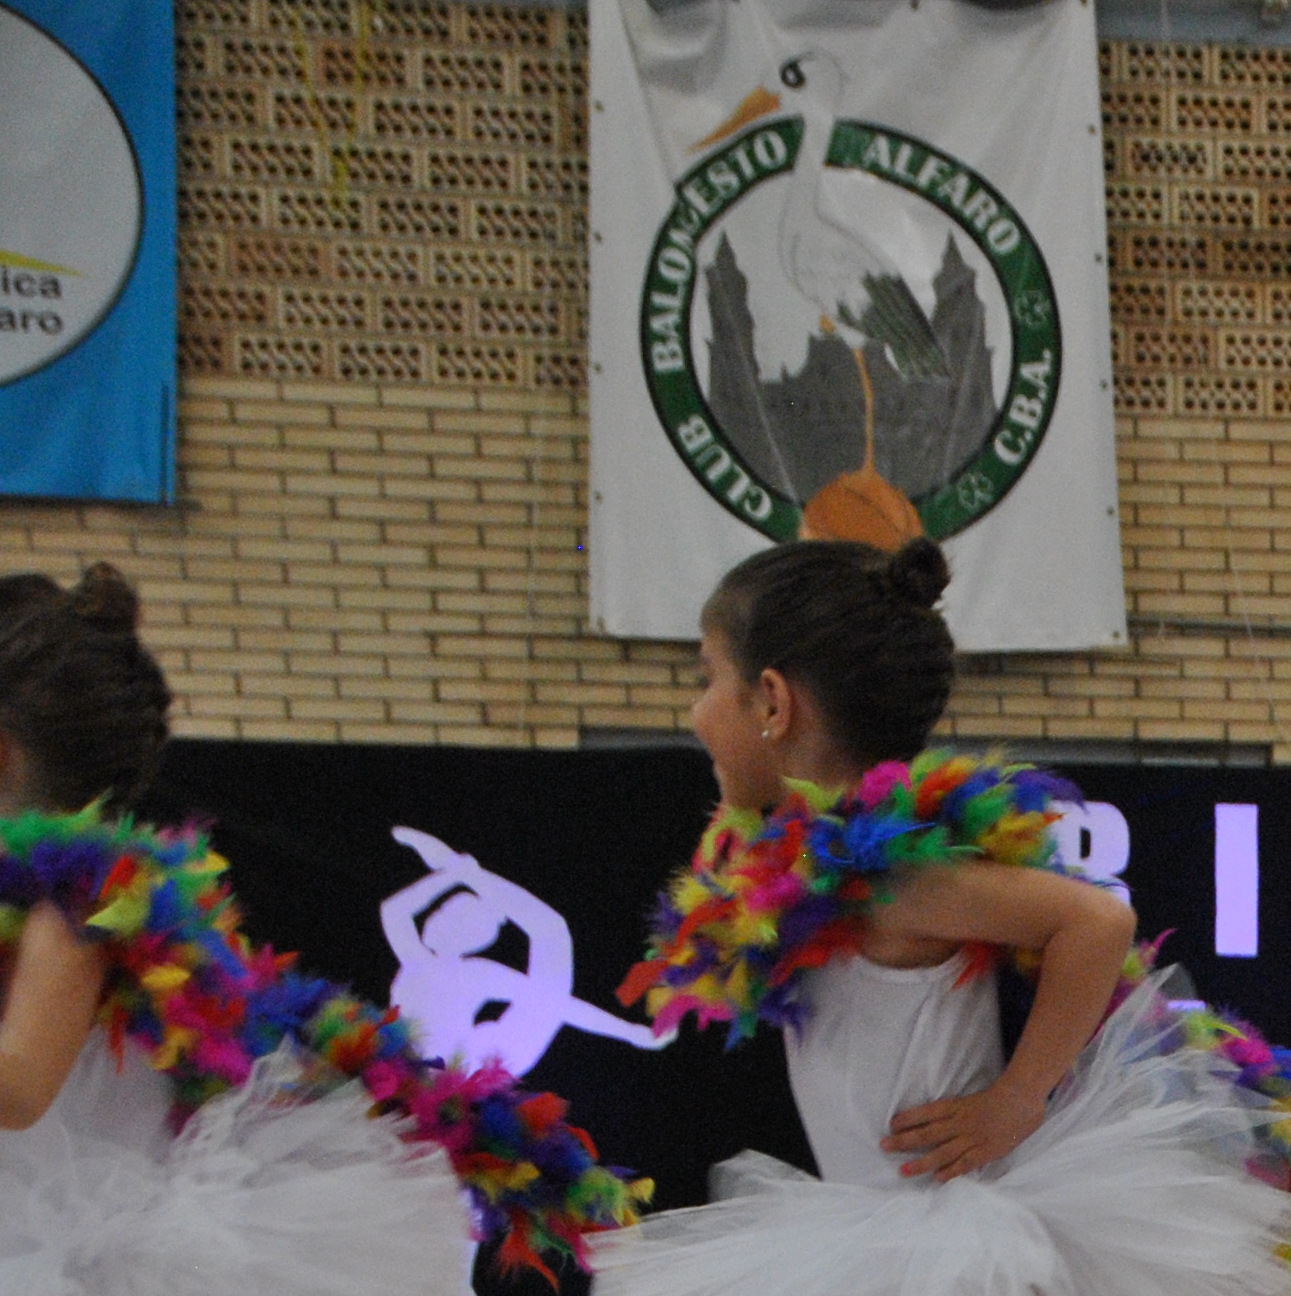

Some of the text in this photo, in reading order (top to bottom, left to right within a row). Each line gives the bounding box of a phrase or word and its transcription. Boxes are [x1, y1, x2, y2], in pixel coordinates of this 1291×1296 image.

[678, 415, 773, 520] CLUB
[865, 135, 1020, 256] ALFARO
[995, 350, 1052, 466] C.B.A.
